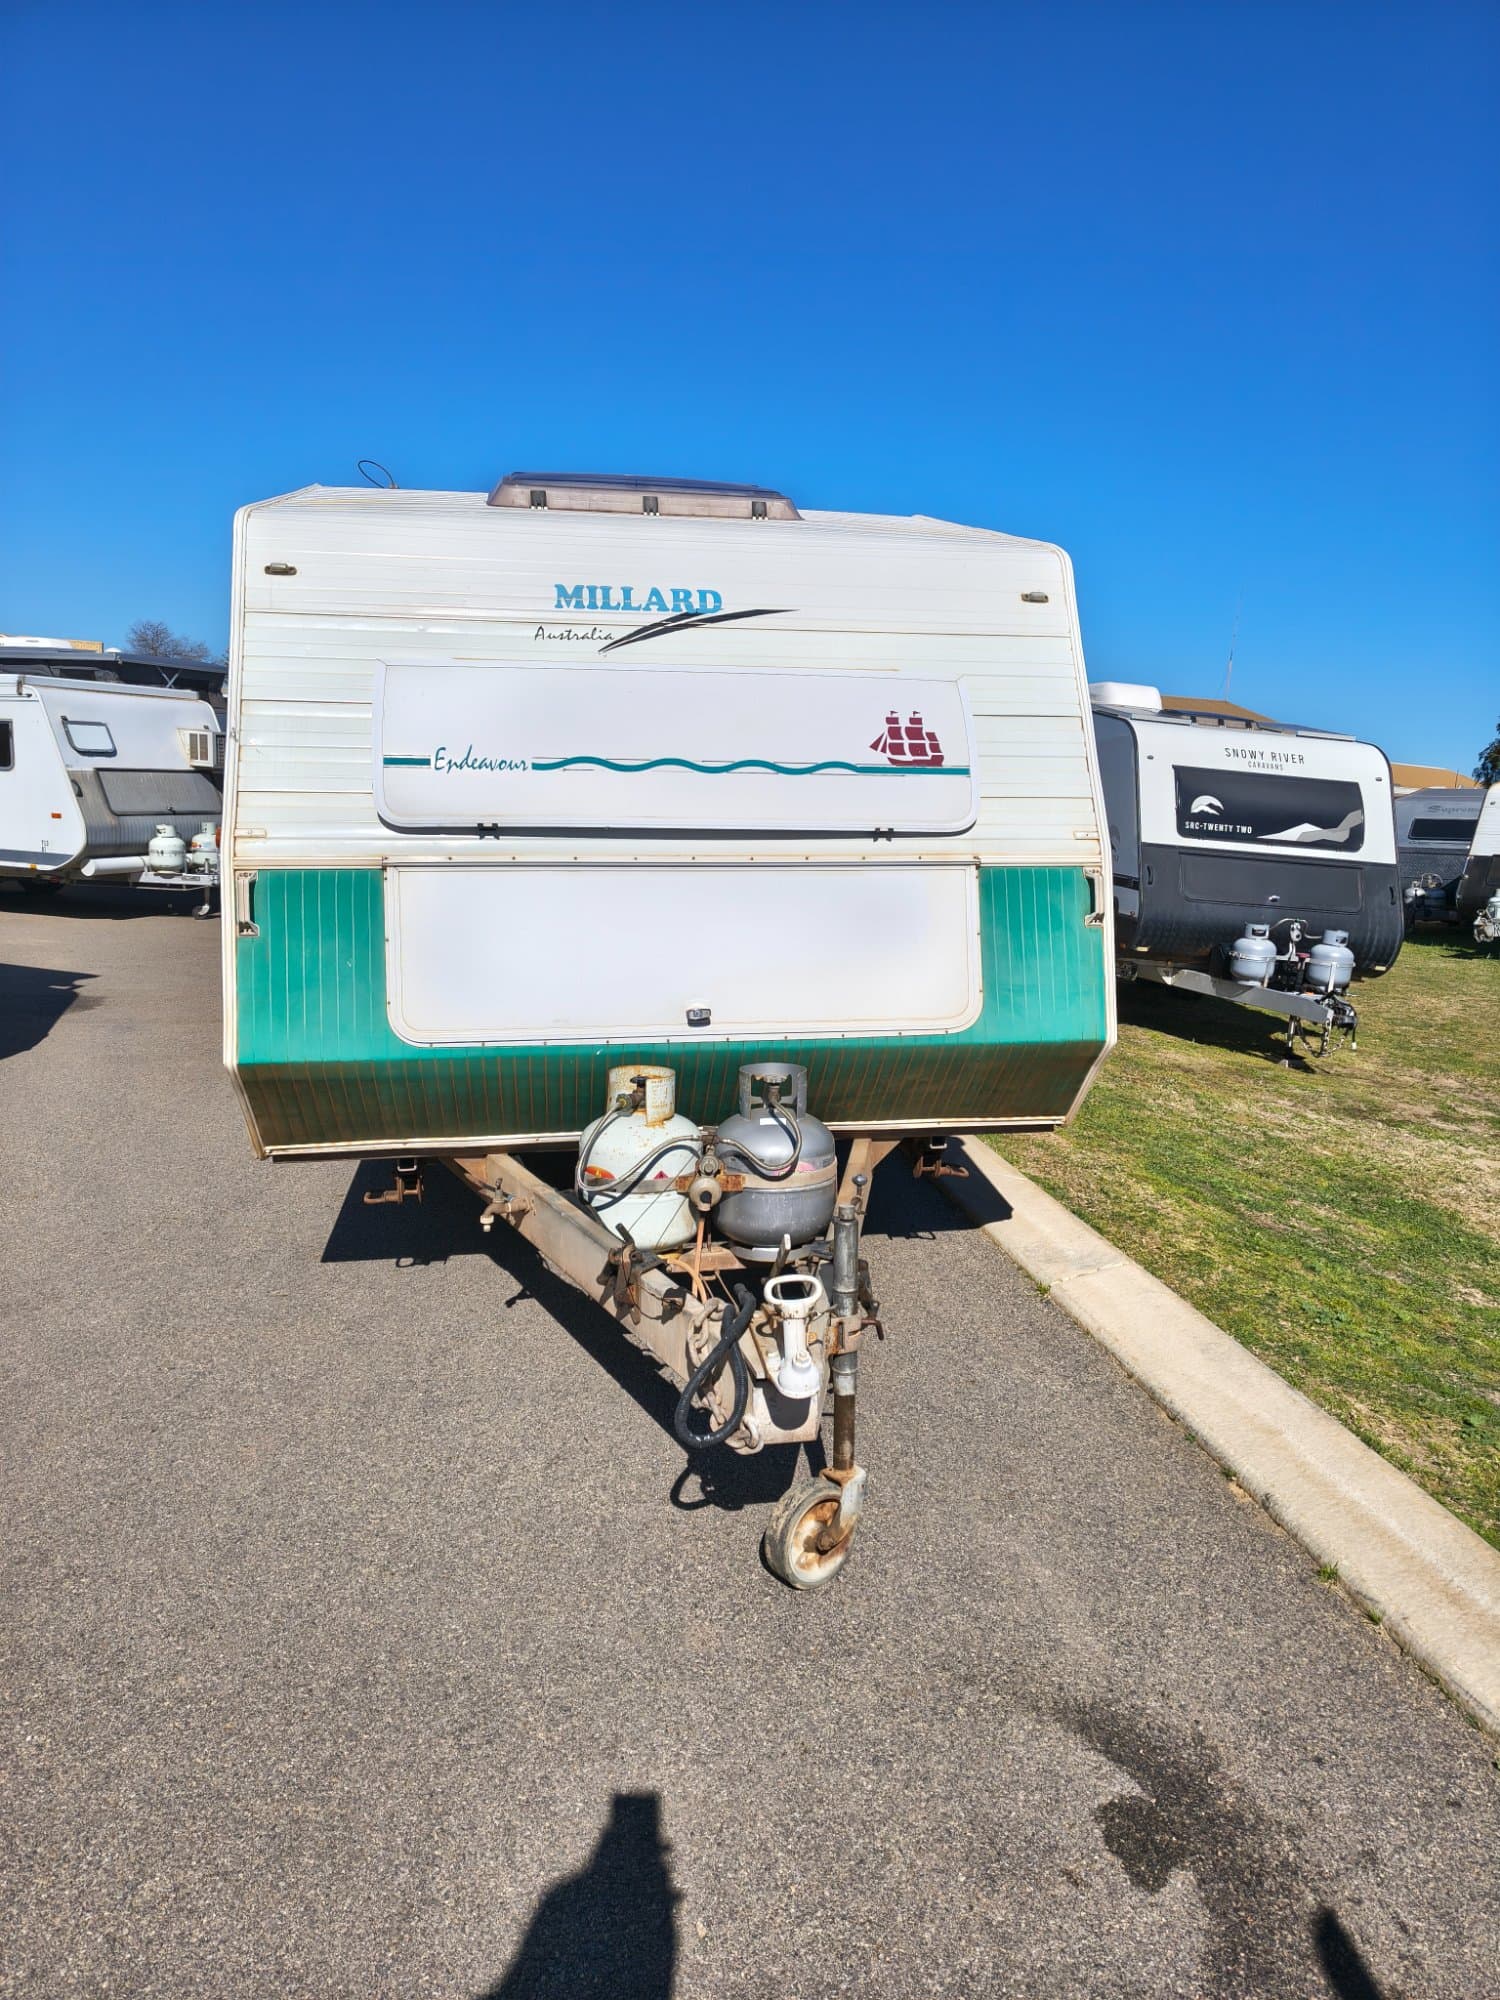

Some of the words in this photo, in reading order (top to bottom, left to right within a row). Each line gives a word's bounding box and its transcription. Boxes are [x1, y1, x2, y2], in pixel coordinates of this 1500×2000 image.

[554, 584, 722, 614] MILLARD
[534, 625, 615, 641] Australia
[434, 744, 528, 774] Endeavour
[1224, 747, 1264, 760] SNOWY
[1271, 751, 1304, 764] RIVER
[1184, 821, 1234, 833] SRC-TWENTY
[1236, 825, 1252, 834] TWO
